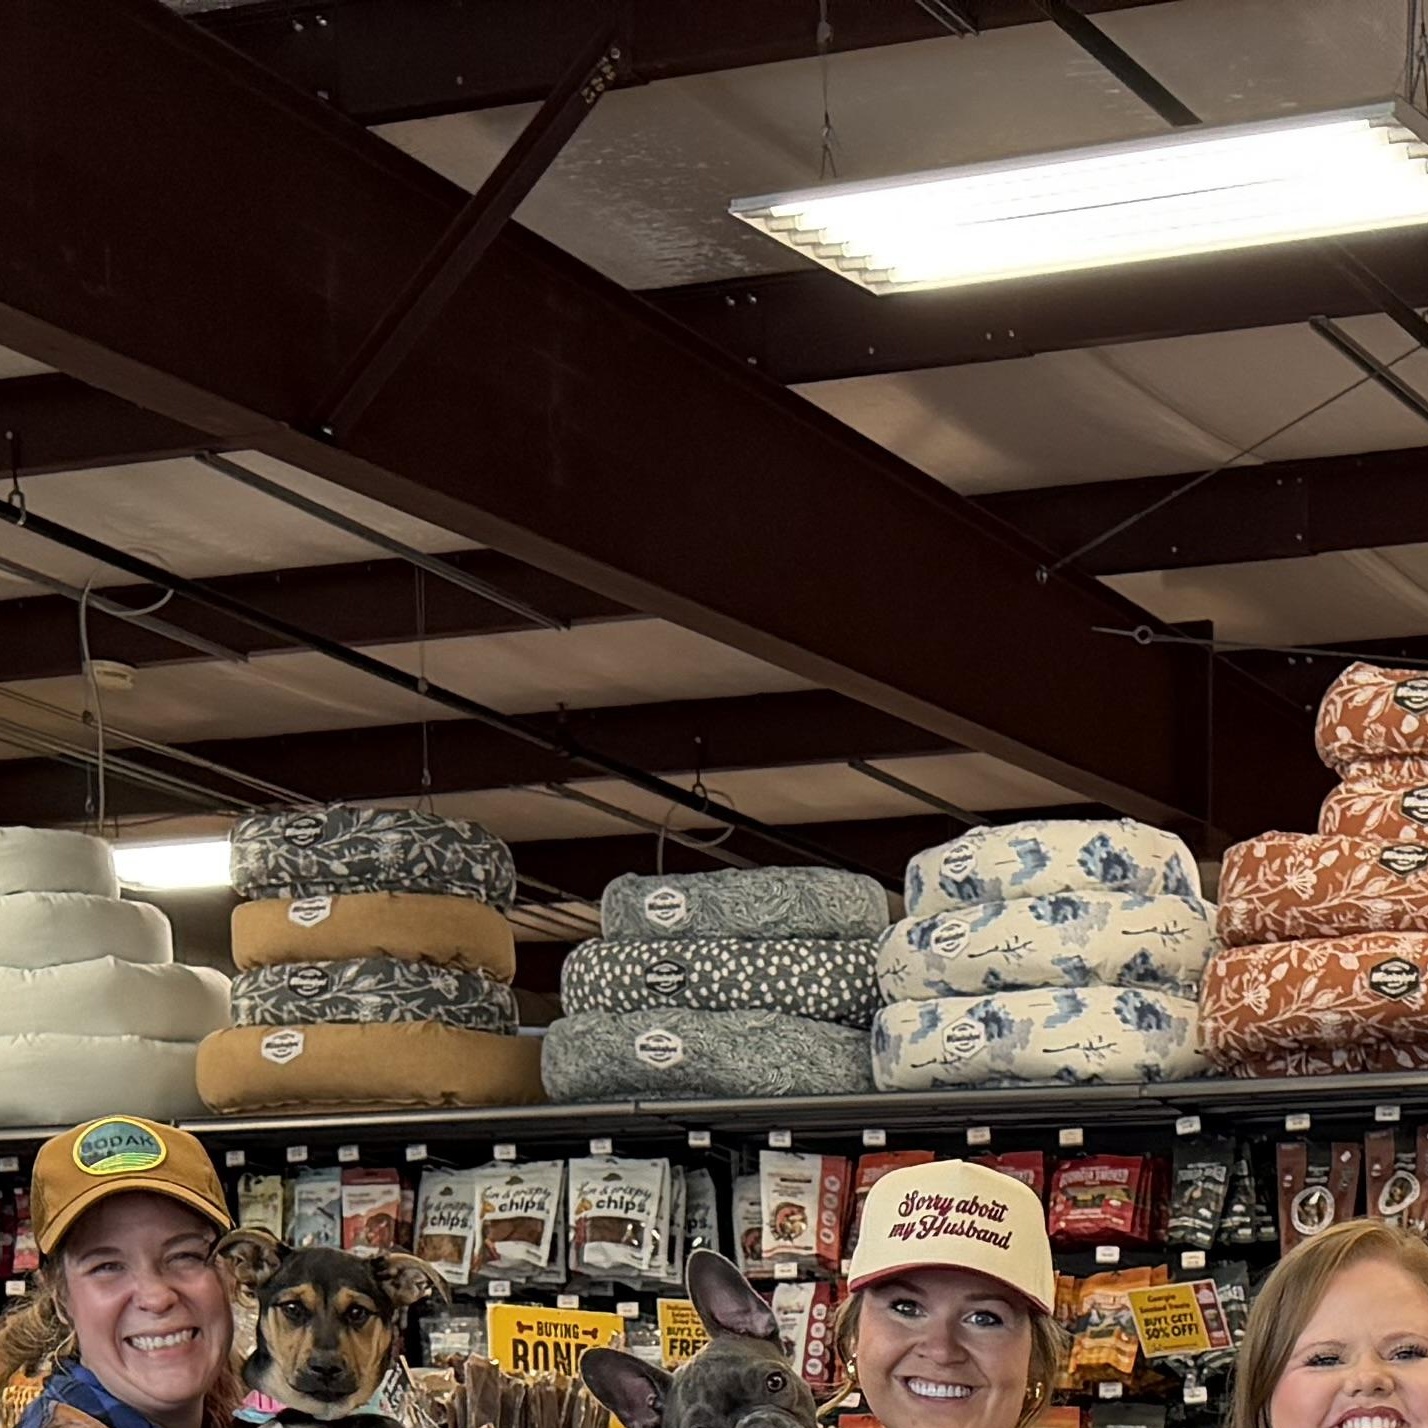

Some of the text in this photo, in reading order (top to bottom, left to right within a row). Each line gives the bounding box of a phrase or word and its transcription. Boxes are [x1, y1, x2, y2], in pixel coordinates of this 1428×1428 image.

[898, 1190, 1009, 1223] Sorry about
[888, 1215, 1013, 1250] my Husband
[536, 1321, 579, 1339] BUYING
